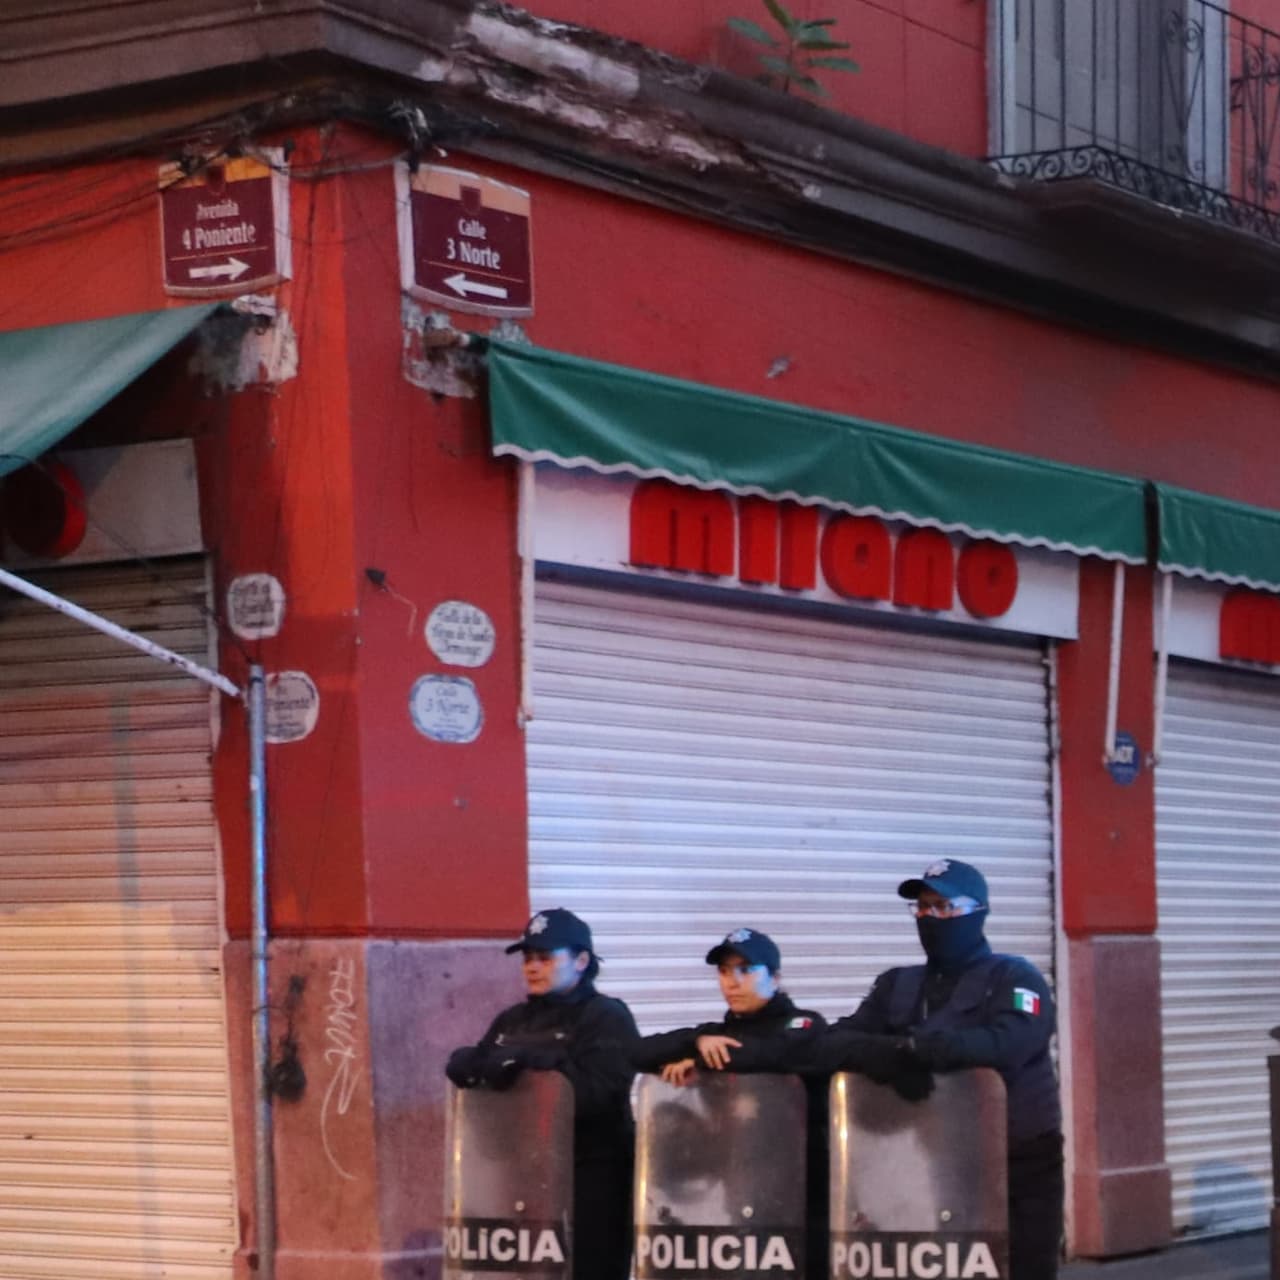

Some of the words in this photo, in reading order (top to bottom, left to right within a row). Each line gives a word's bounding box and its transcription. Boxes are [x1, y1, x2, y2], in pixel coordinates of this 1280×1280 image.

[196, 199, 239, 219] Avenida
[182, 229, 191, 250] 4
[195, 222, 256, 249] Poniente
[458, 218, 486, 239] Calle
[446, 238, 456, 259] 3
[460, 240, 501, 269] Norte
[629, 479, 1019, 618] milano
[636, 1234, 796, 1271] POLICIA
[832, 1241, 1000, 1280] POLICIA
